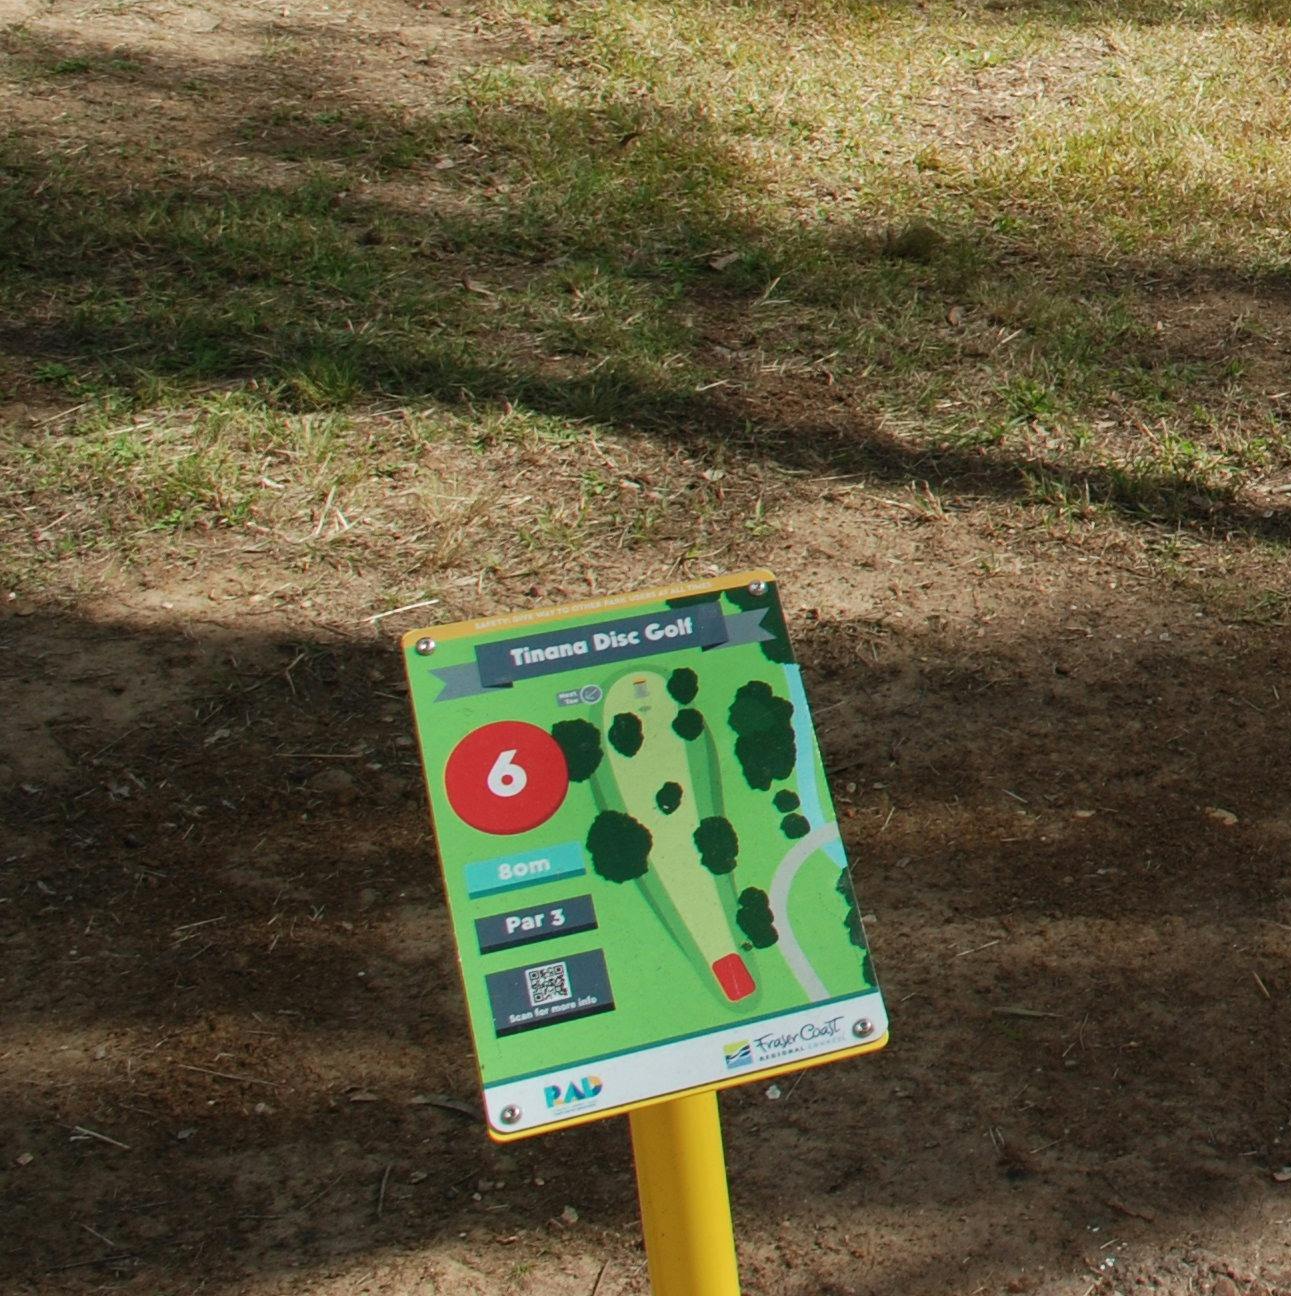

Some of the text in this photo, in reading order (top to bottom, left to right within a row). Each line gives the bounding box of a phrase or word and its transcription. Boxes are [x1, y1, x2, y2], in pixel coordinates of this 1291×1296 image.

[510, 617, 693, 666] Tinana Disc Golf
[487, 749, 528, 797] 6
[506, 908, 566, 934] Par 3
[509, 995, 598, 1023] Scan for more info
[754, 1016, 844, 1052] Fraser Coast
